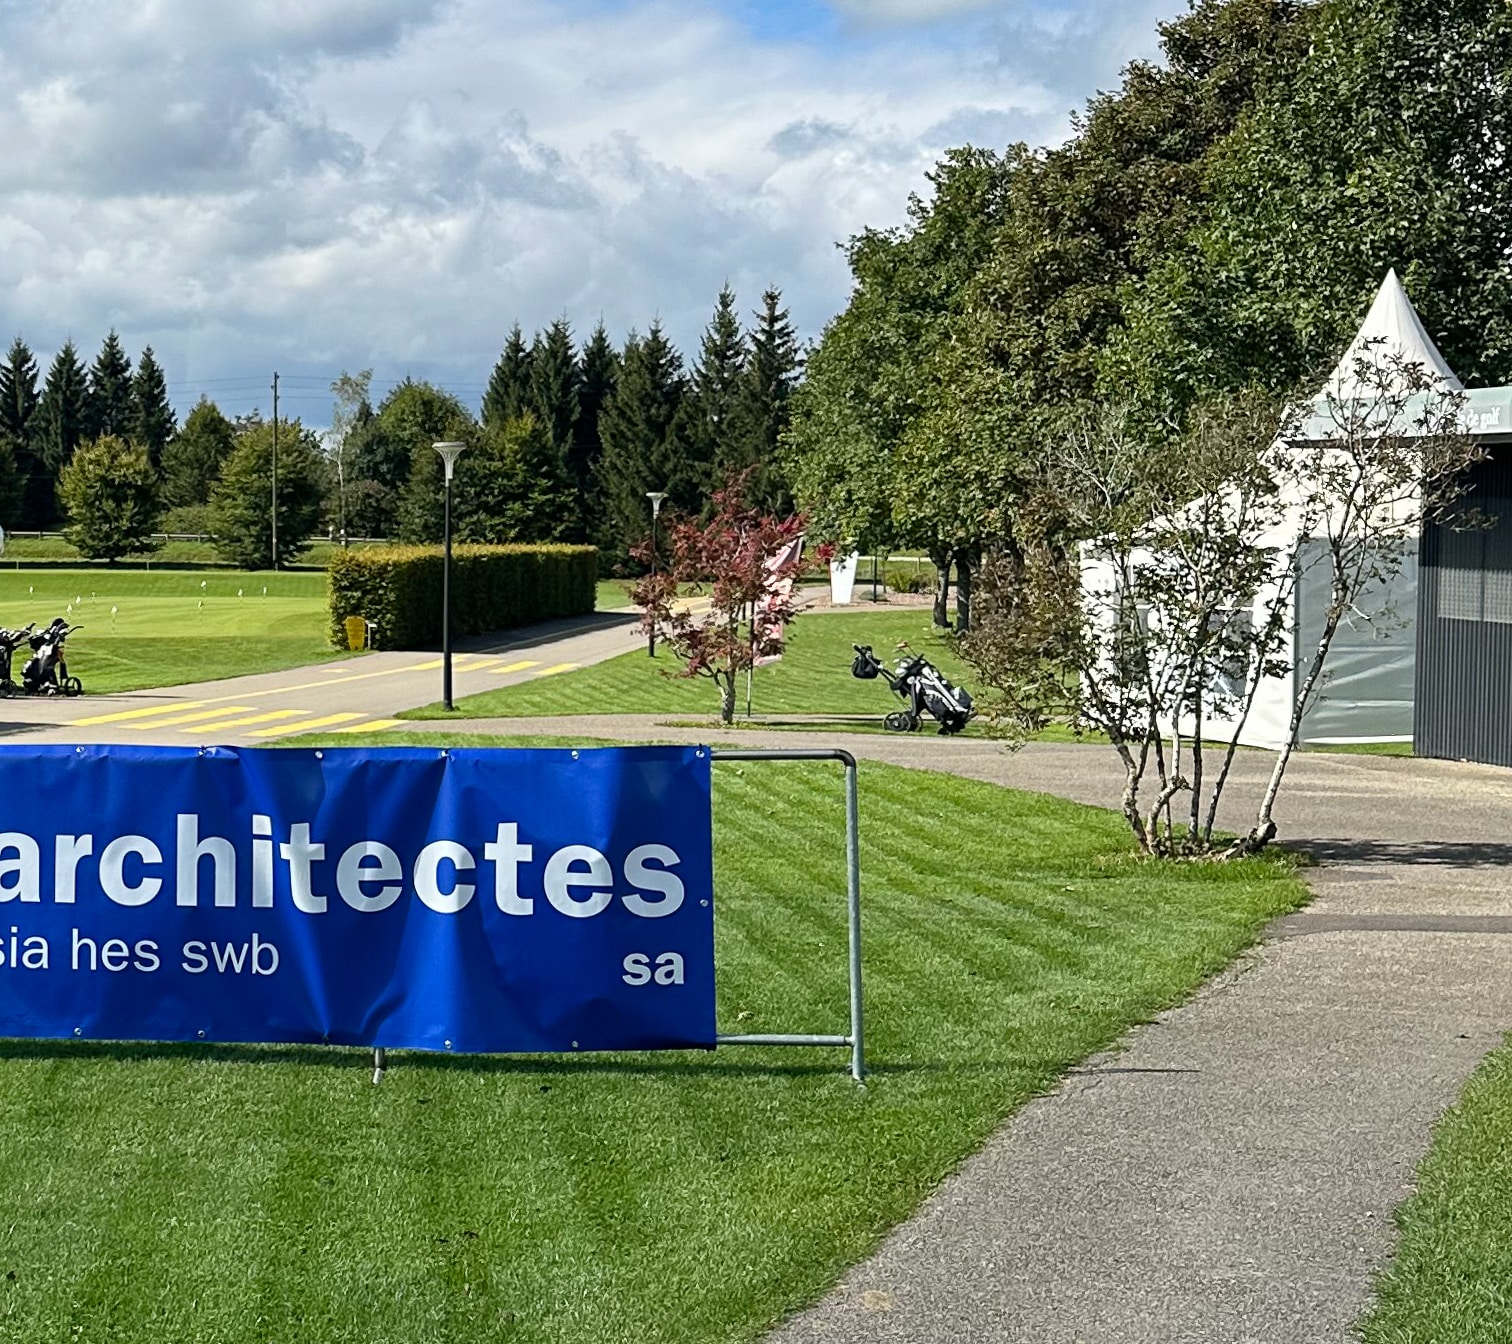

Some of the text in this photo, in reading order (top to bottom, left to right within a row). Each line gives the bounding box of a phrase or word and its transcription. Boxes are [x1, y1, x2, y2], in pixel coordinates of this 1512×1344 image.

[1480, 406, 1501, 430] golf
[70, 928, 161, 972] hes
[181, 932, 280, 976] swb
[621, 952, 685, 986] sa
